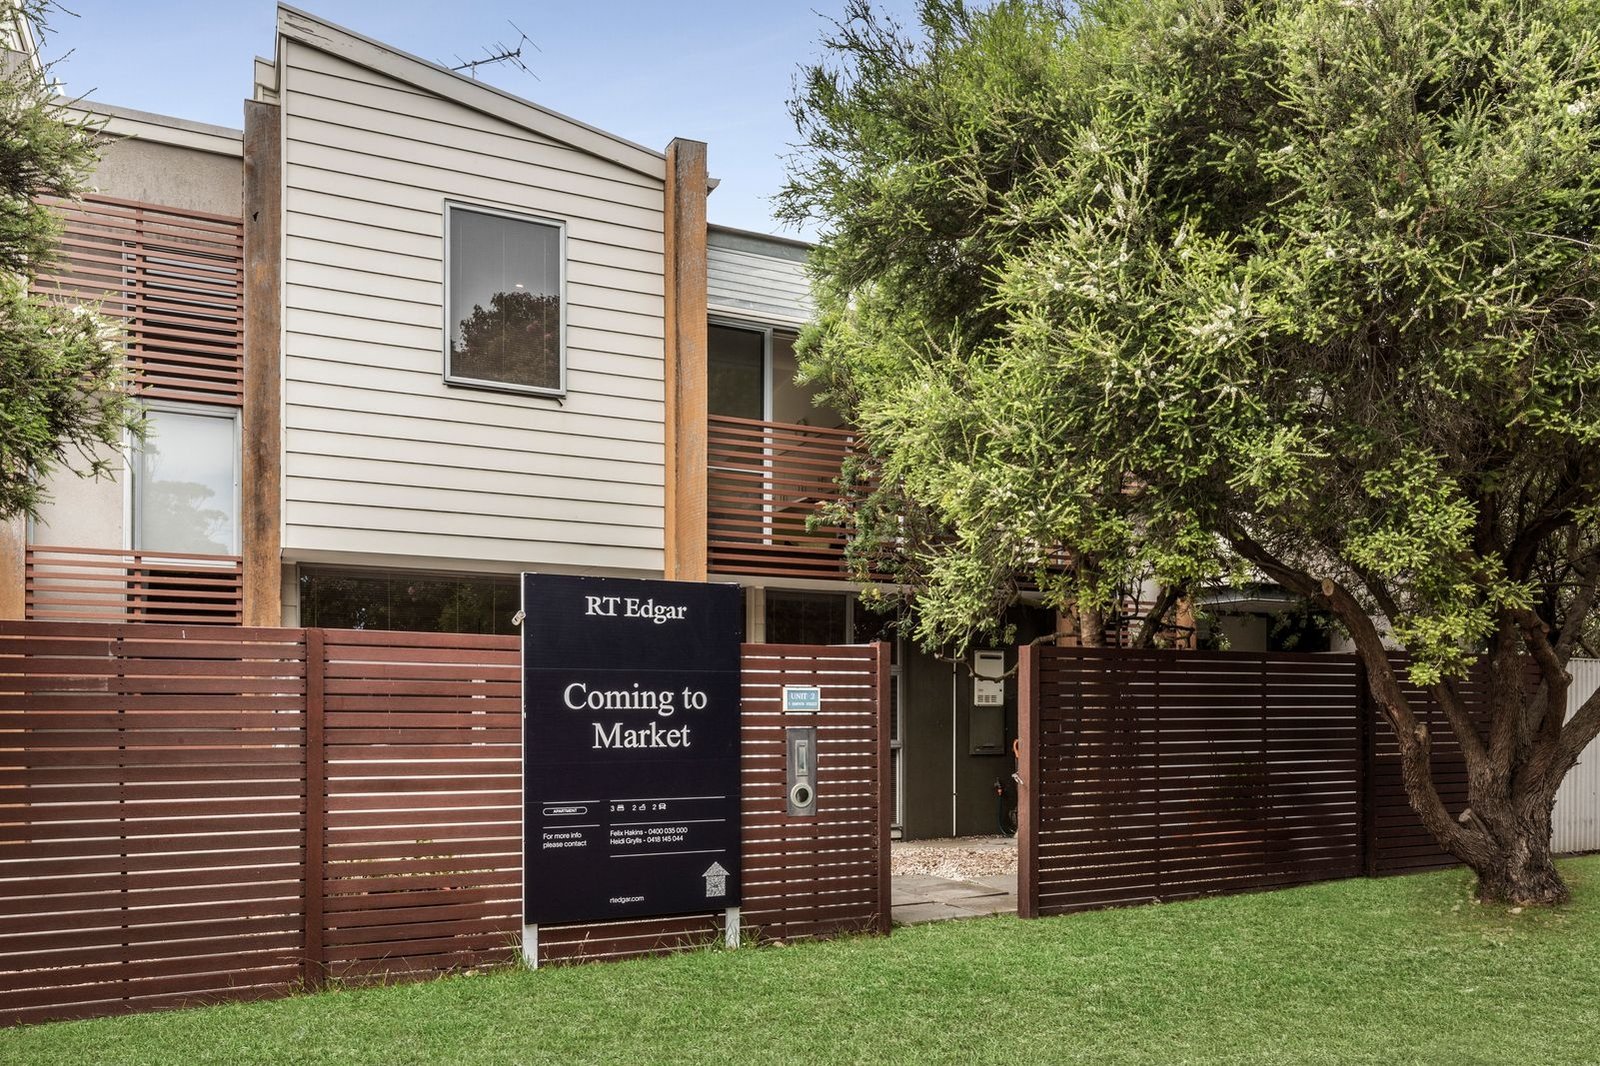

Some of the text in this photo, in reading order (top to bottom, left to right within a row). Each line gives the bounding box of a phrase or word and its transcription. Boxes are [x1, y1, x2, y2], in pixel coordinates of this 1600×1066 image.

[585, 595, 688, 624] RT Edgar
[563, 682, 708, 717] Coming to
[592, 721, 692, 749] Market
[652, 803, 657, 811] 2
[570, 831, 583, 839] info
[609, 829, 624, 837] Felix
[676, 826, 688, 834] 000
[542, 840, 587, 850] please contact
[609, 837, 625, 845] Heidi
[609, 895, 645, 904] rtedgar.com
